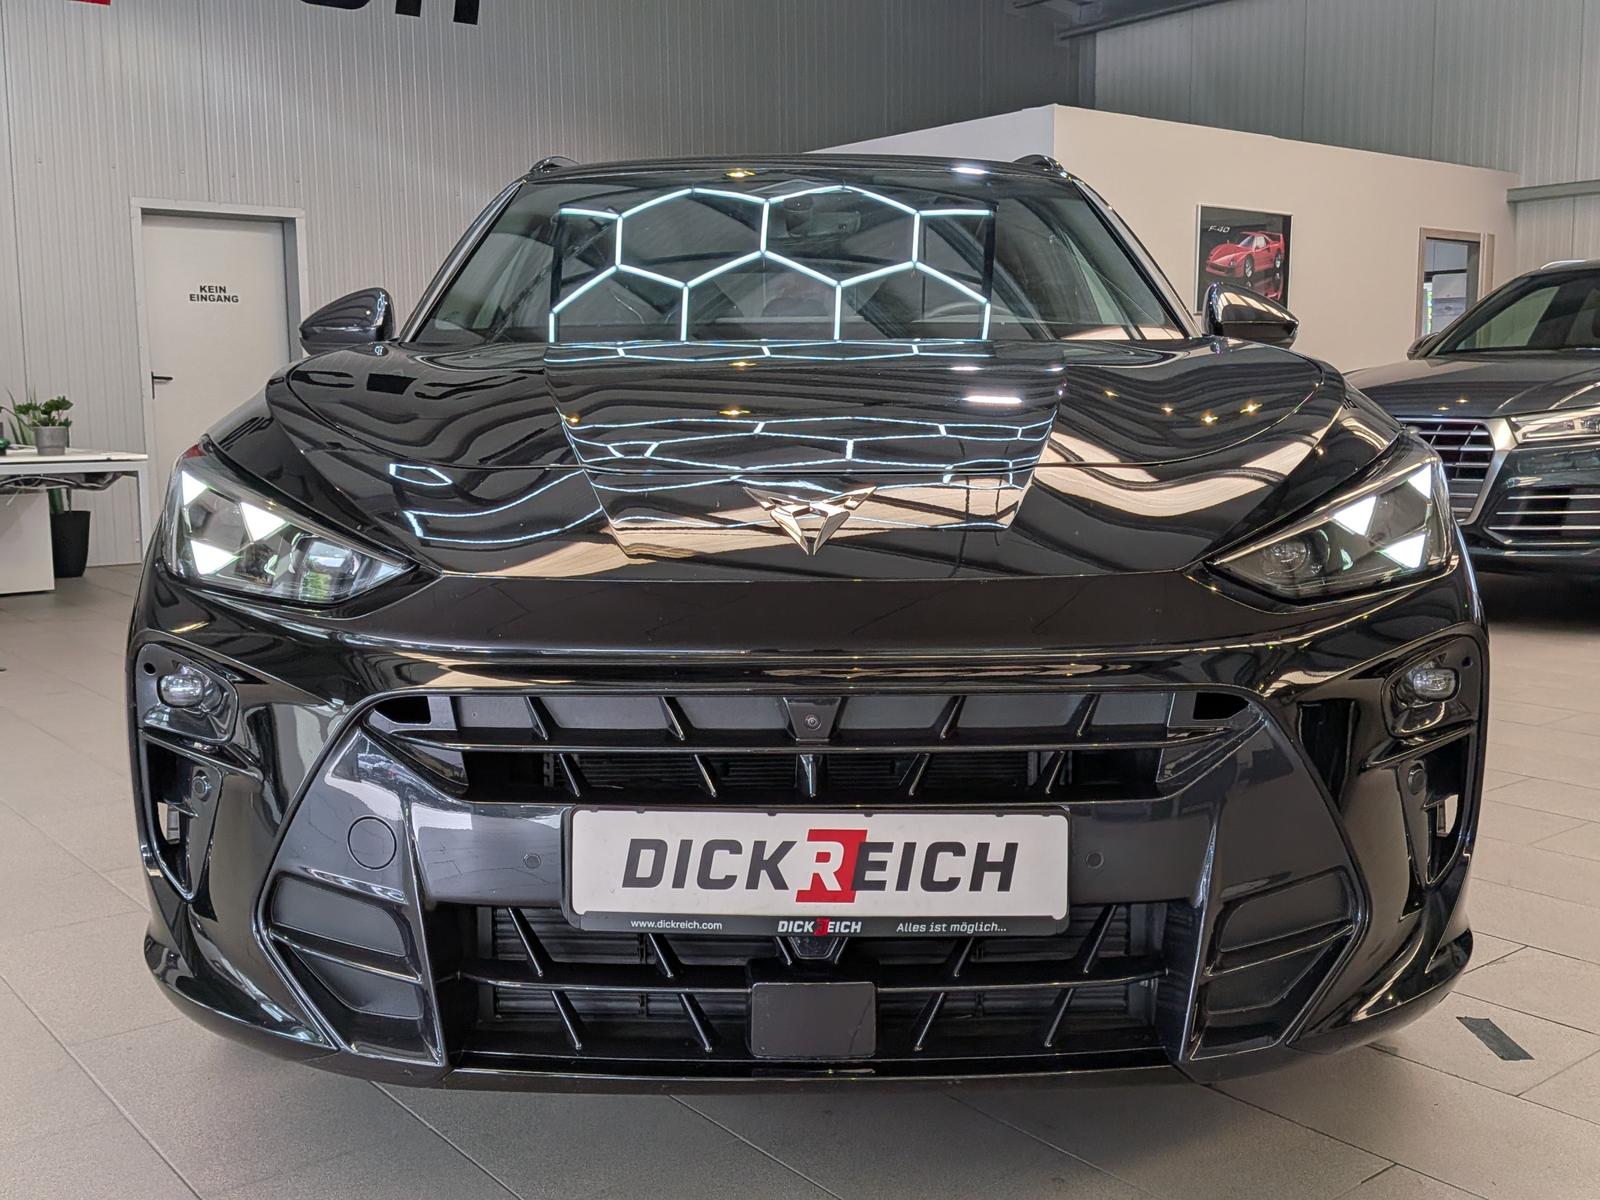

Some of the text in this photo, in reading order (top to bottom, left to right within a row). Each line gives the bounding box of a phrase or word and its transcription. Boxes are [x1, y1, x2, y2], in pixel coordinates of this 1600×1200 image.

[199, 285, 227, 293] KEIN
[189, 294, 239, 303] EINGANG
[621, 829, 1018, 903] DICKREICH
[630, 919, 723, 931] www.dickreich.com
[896, 921, 1007, 935] Alles ist möglich...
